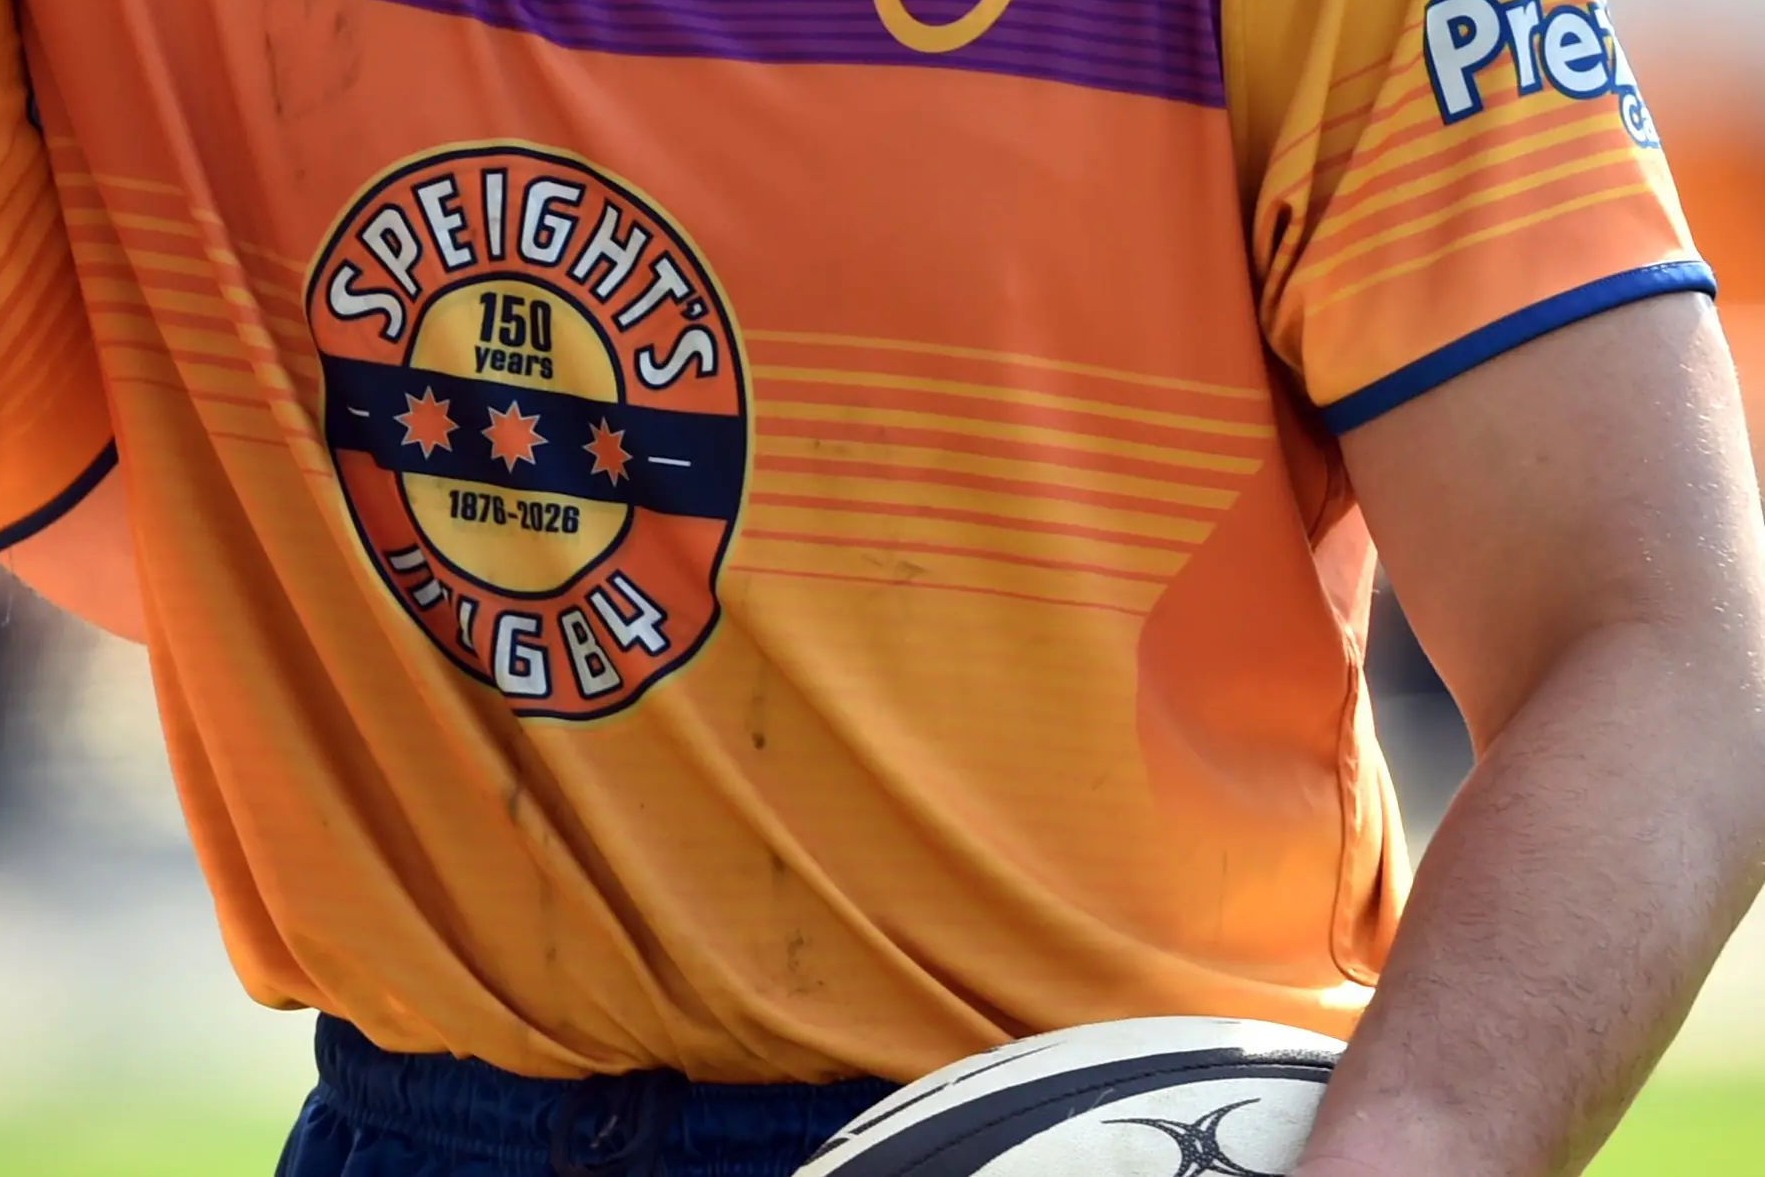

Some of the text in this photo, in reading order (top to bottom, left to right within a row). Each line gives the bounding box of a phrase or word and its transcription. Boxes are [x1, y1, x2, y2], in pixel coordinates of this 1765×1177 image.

[326, 167, 718, 390] SPEIGHT'S
[478, 291, 552, 352] 150
[474, 344, 554, 379] years
[448, 489, 580, 534] 1876-2026
